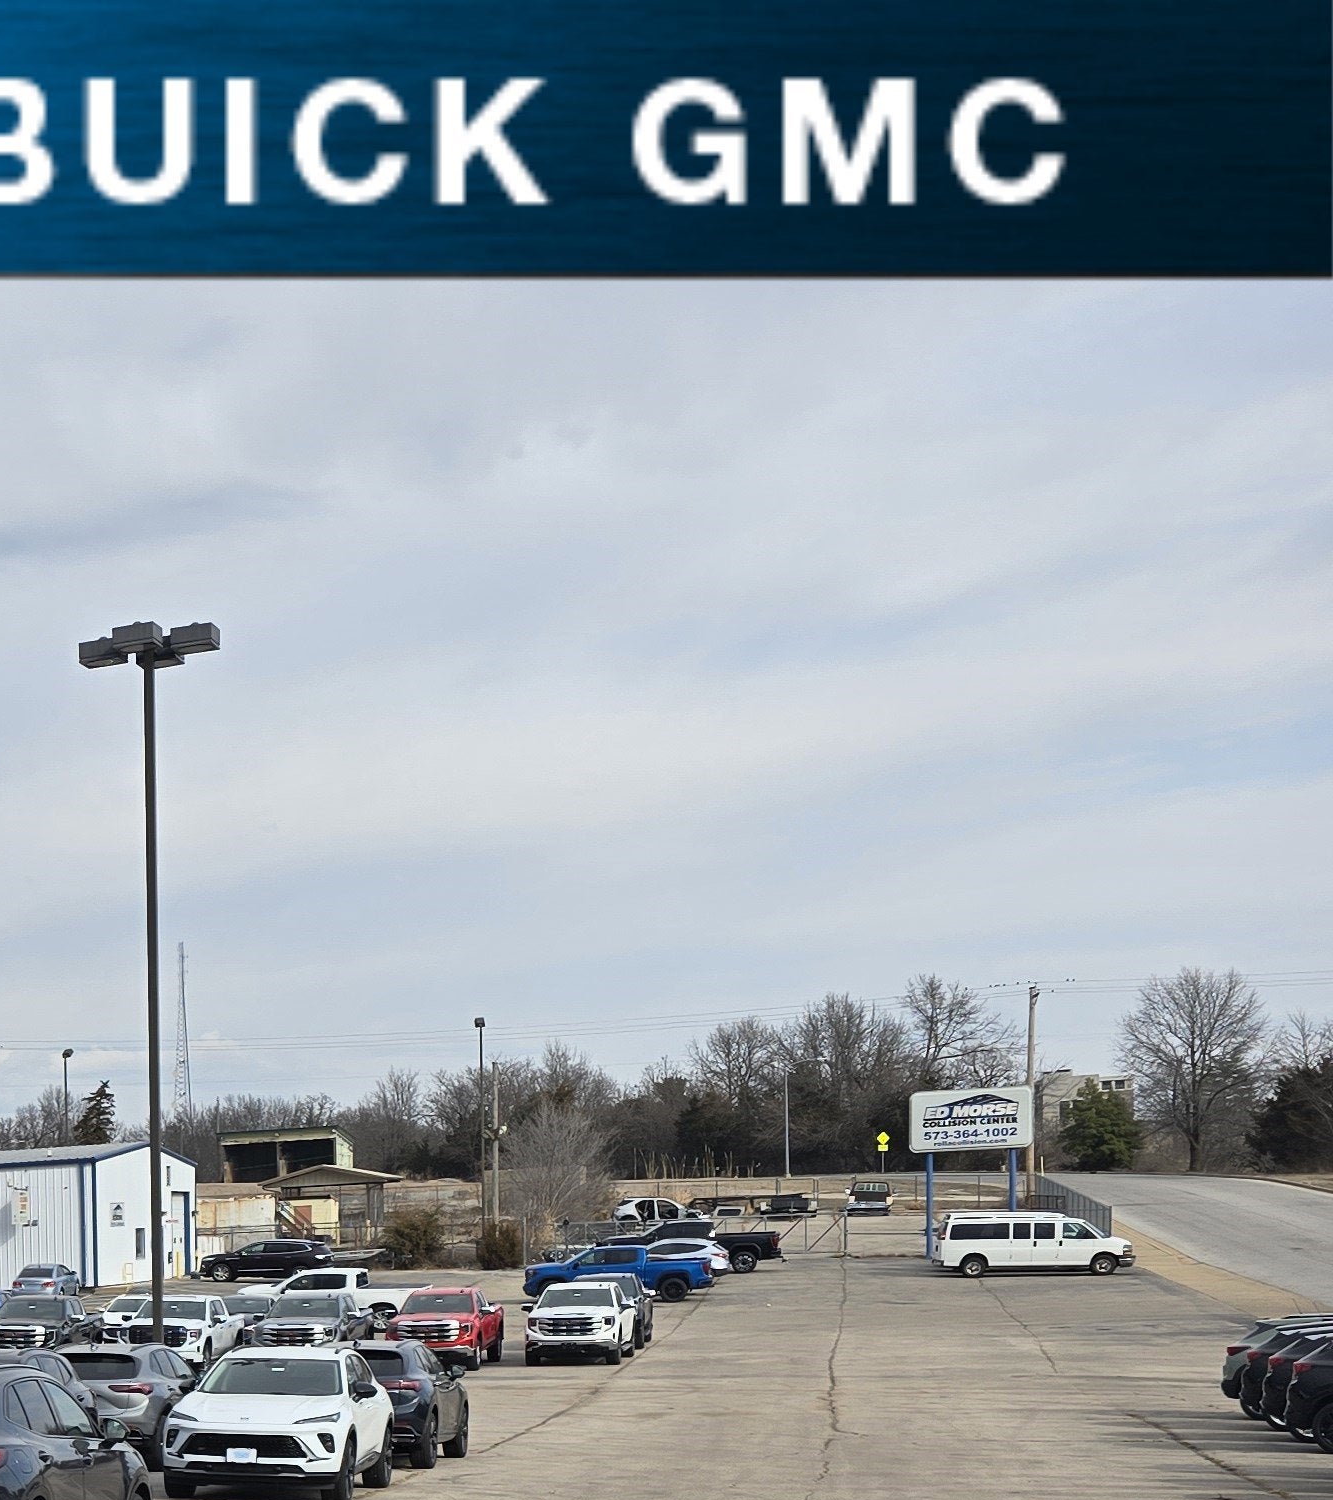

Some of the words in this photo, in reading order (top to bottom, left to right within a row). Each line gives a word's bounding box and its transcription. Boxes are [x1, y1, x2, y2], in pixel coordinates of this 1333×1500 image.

[924, 1106, 949, 1119] ED
[951, 1102, 1018, 1117] MORSE
[923, 1119, 977, 1128] COLLISION
[979, 1116, 1018, 1125] CENTER
[924, 1127, 1017, 1140] 573-364-1002
